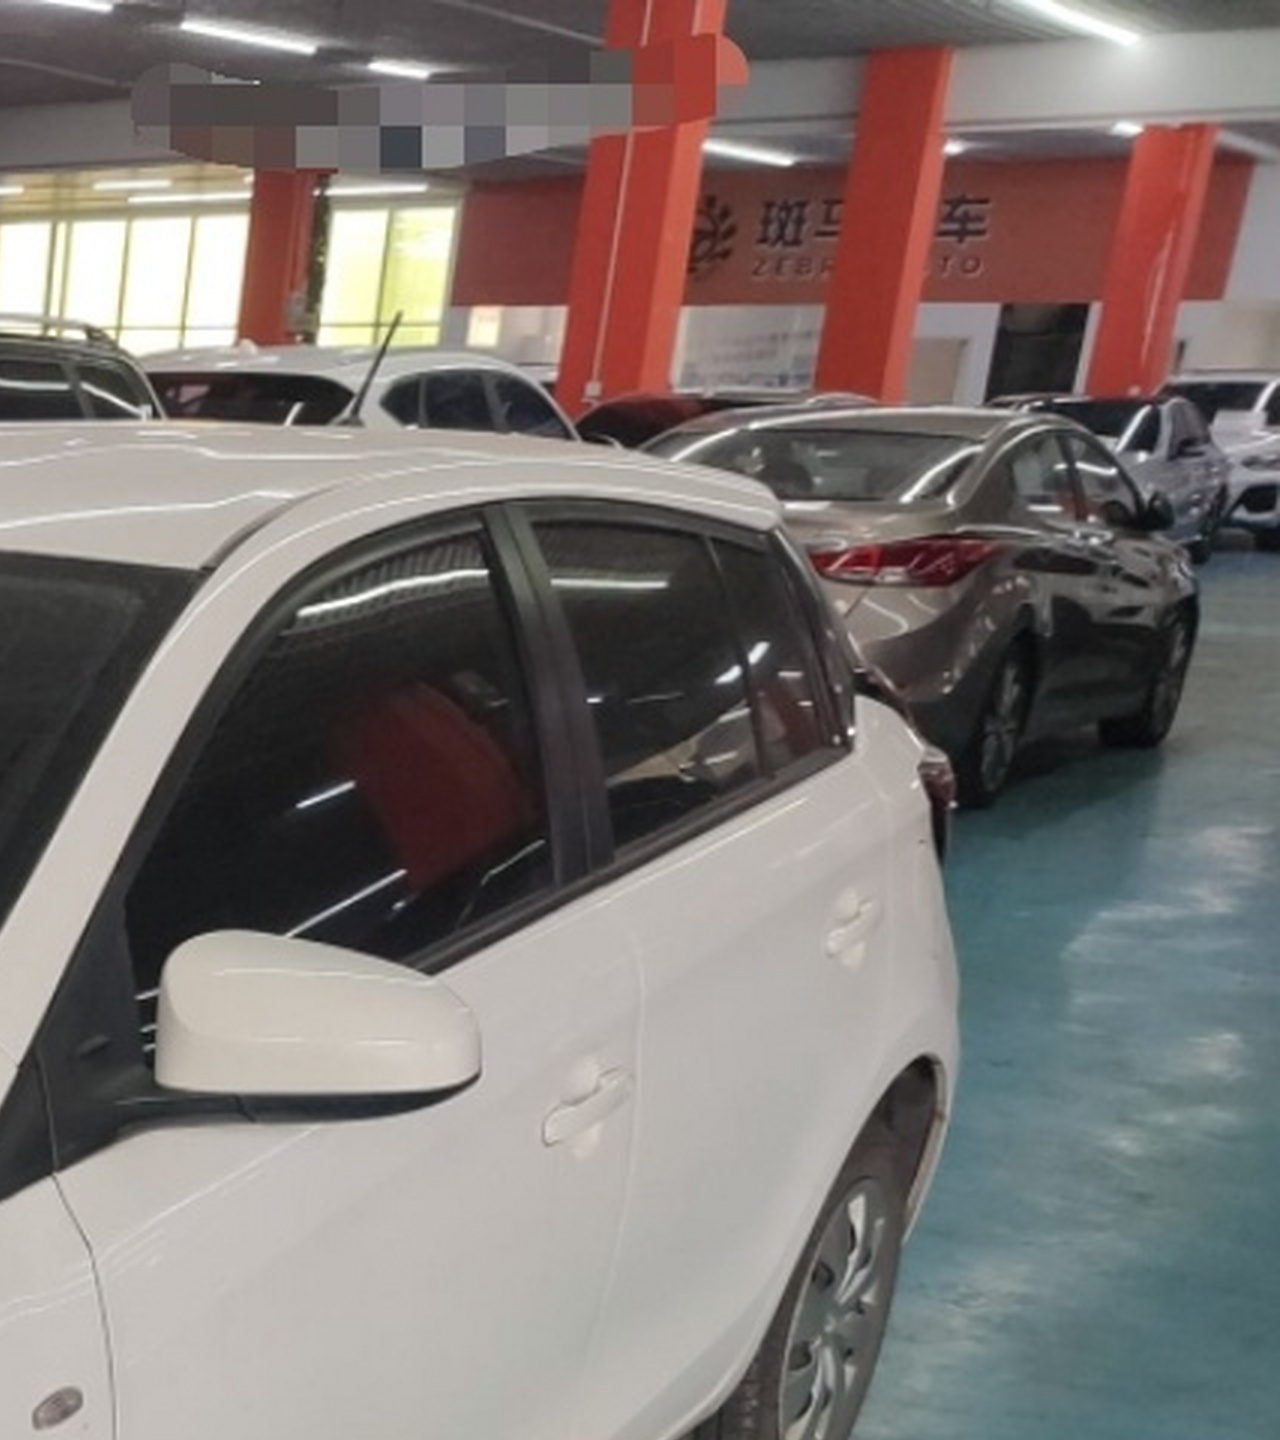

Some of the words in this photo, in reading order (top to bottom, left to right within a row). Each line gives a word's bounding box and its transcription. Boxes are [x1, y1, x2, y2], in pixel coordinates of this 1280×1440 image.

[755, 194, 991, 247] 斑马车
[751, 255, 838, 277] ZEBR
